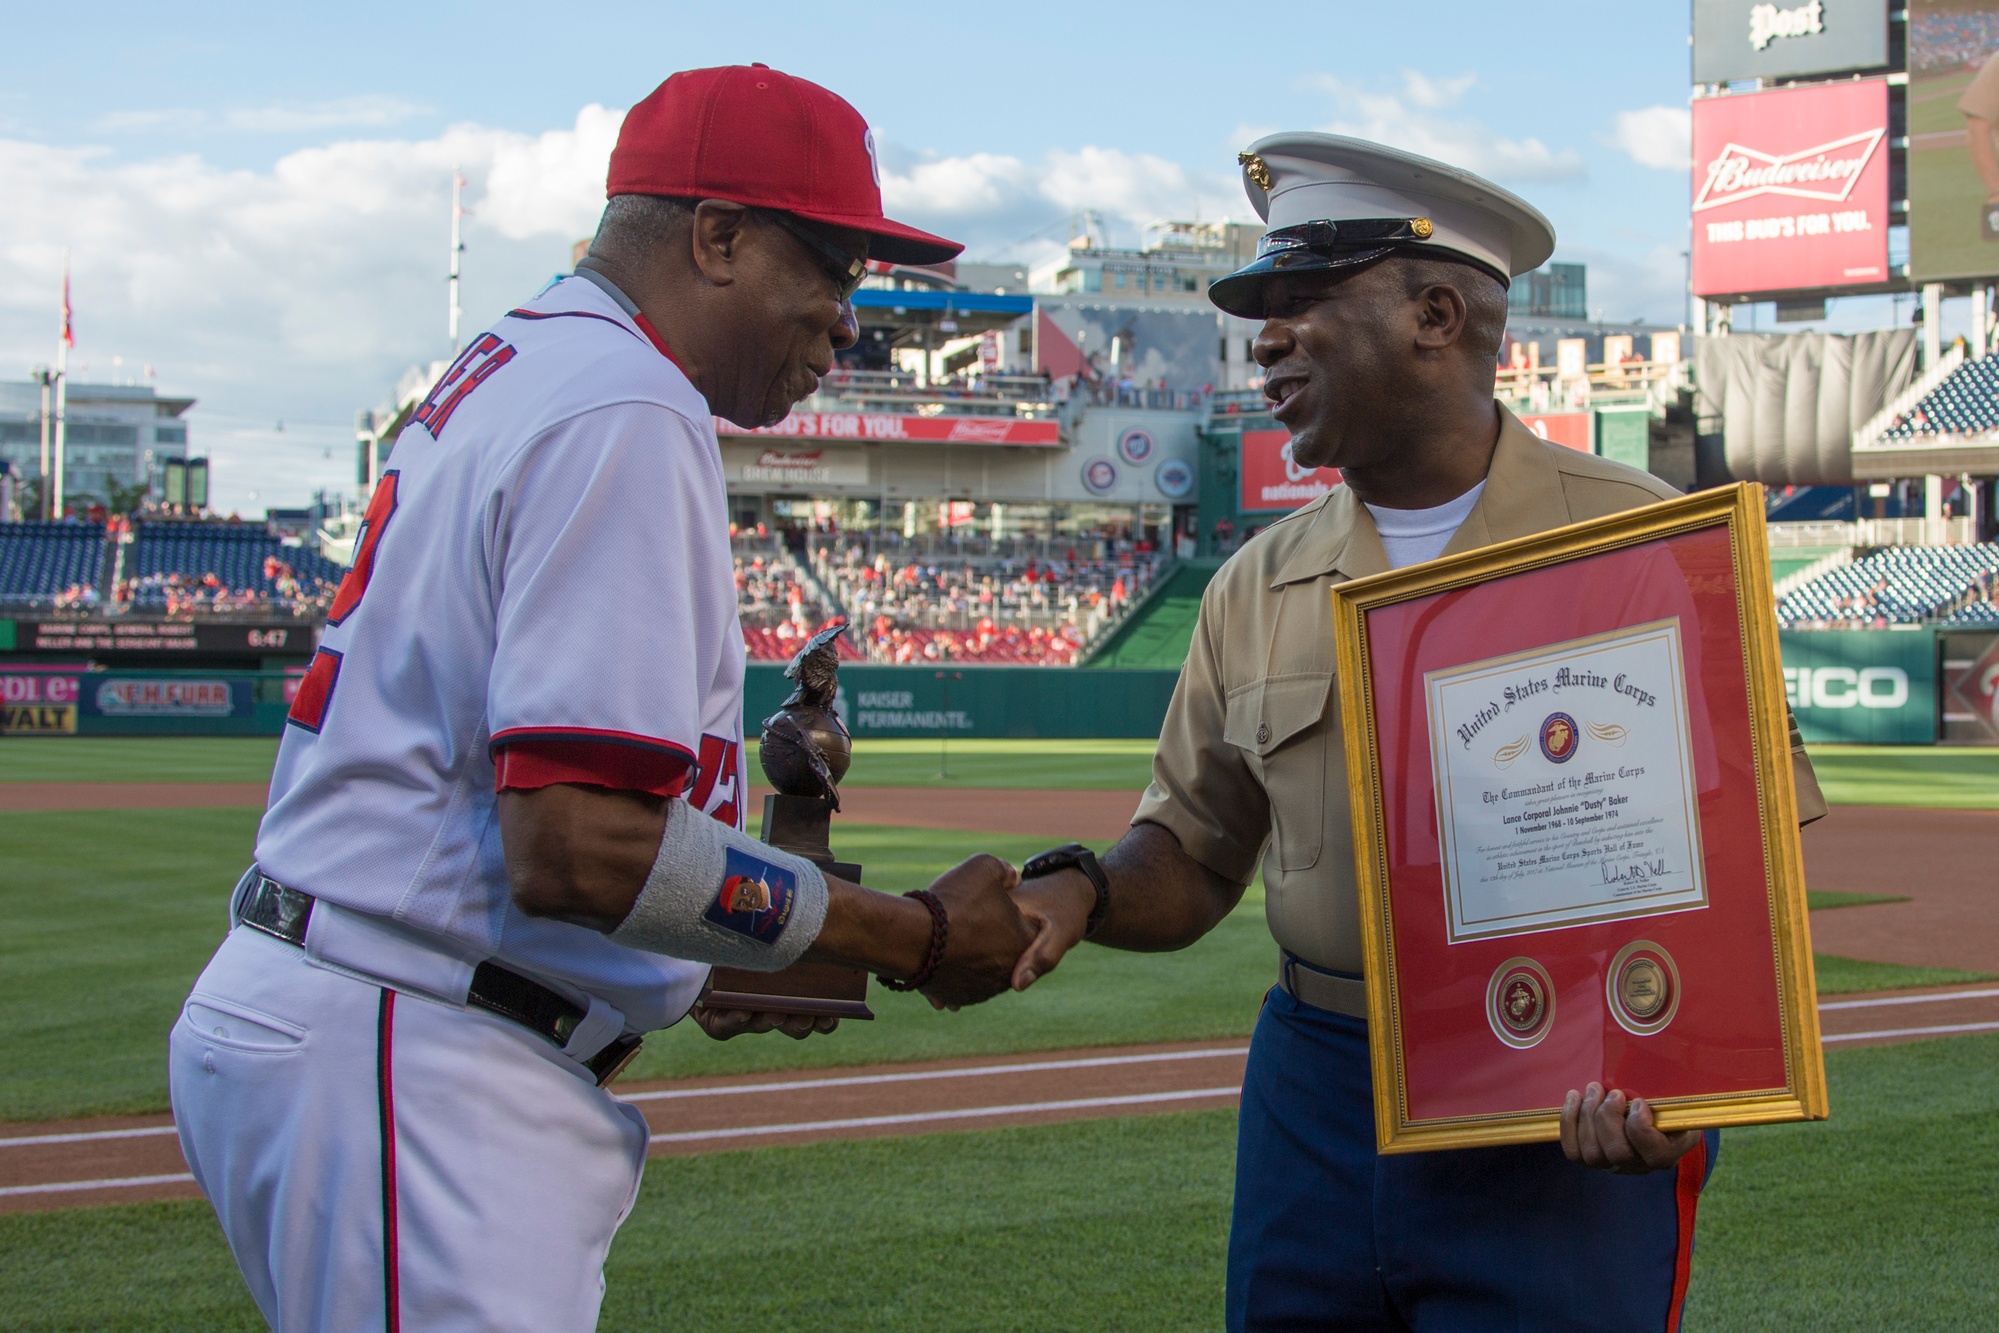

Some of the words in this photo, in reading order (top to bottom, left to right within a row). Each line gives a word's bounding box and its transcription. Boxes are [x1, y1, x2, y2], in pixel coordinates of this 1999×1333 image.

[1749, 0, 1822, 50] Post
[1707, 155, 1863, 192] Budweiser
[1706, 220, 1744, 243] THIS
[1745, 216, 1795, 240] BUD'S
[1797, 213, 1830, 236] FOR
[1832, 210, 1872, 233] YOU.
[820, 415, 860, 436] FOR
[863, 416, 908, 438] YOU.
[1262, 481, 1341, 501] nationals
[247, 629, 287, 647] 6:47
[857, 691, 914, 707] KAISER
[1456, 701, 1501, 751] United
[1503, 678, 1549, 713] States
[1553, 667, 1608, 694] Marine
[1613, 672, 1656, 707] Corps
[1483, 792, 1498, 805] The
[1502, 783, 1554, 800] Commandant
[1558, 778, 1566, 790] of
[1569, 777, 1581, 790] the
[1584, 772, 1615, 789] Marine
[1619, 766, 1645, 778] Corps
[1503, 816, 1522, 825] Lance
[1523, 807, 1551, 821] Corporal
[1553, 804, 1579, 816] Johnnie
[1609, 795, 1628, 806] Baker
[1515, 827, 1518, 835] 1
[1520, 824, 1547, 834] November
[1548, 820, 1562, 829] 1968
[1567, 818, 1574, 826] 10
[1575, 814, 1603, 825] September
[1605, 810, 1619, 819] 1974
[1498, 861, 1516, 873] United
[1518, 859, 1537, 867] States
[1539, 855, 1560, 866] Marine
[1562, 852, 1580, 860] Corps
[1582, 848, 1602, 858] Sports
[1604, 844, 1617, 855] Hall
[1620, 842, 1625, 851] of
[1627, 841, 1644, 852] Fame
